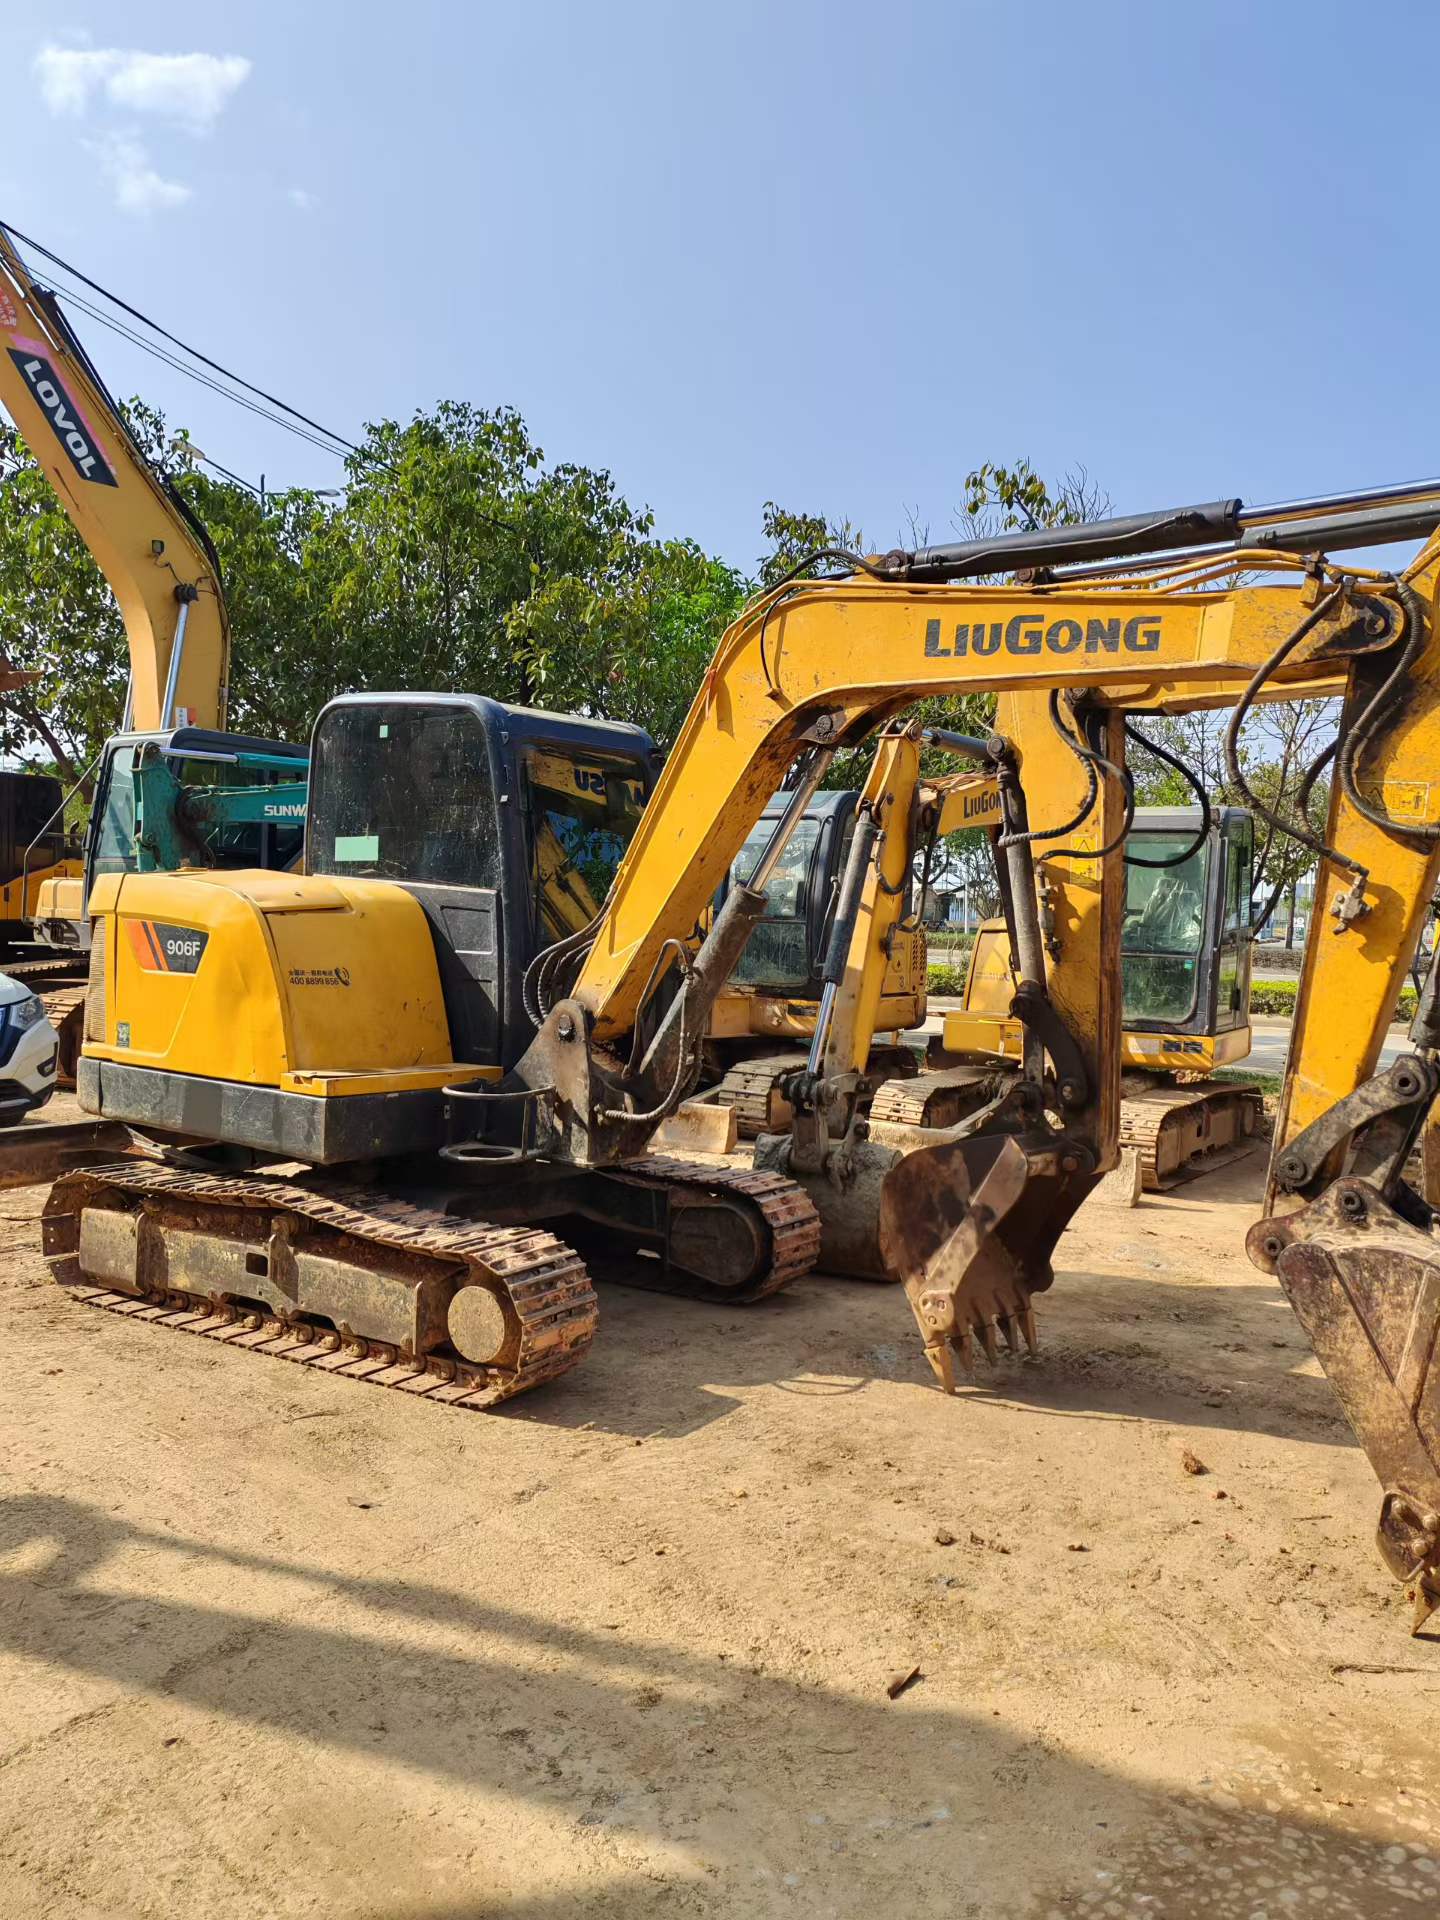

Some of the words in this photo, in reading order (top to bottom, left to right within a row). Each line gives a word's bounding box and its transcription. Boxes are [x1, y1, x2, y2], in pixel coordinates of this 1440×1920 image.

[23, 360, 97, 478] LOVOL
[963, 790, 1002, 819] LIUGON
[167, 939, 201, 957] 906F
[289, 976, 305, 985] 400
